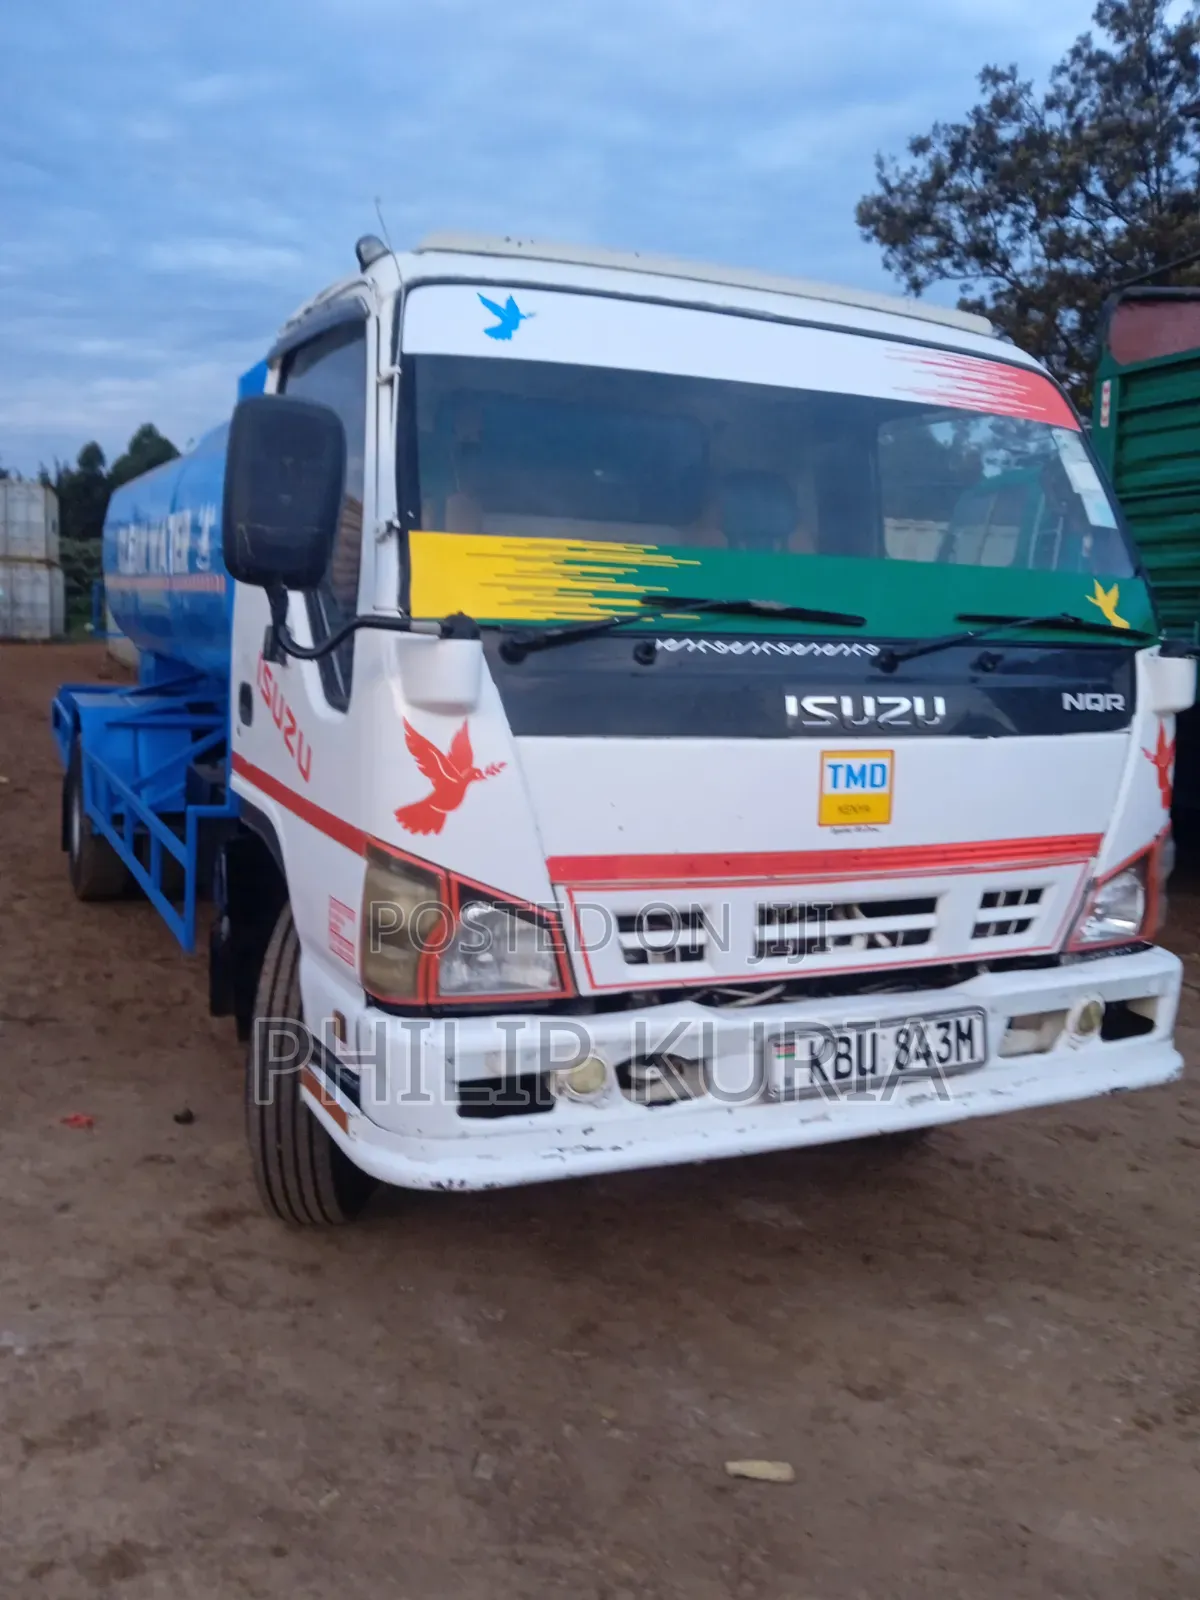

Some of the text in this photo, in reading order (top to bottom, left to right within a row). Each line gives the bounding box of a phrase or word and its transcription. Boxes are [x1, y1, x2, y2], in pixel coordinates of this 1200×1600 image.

[257, 650, 312, 783] ISUZU
[784, 694, 947, 727] ISUZU
[1061, 692, 1126, 712] NQR
[827, 763, 887, 789] TMD
[809, 1018, 976, 1084] KBU 843M
